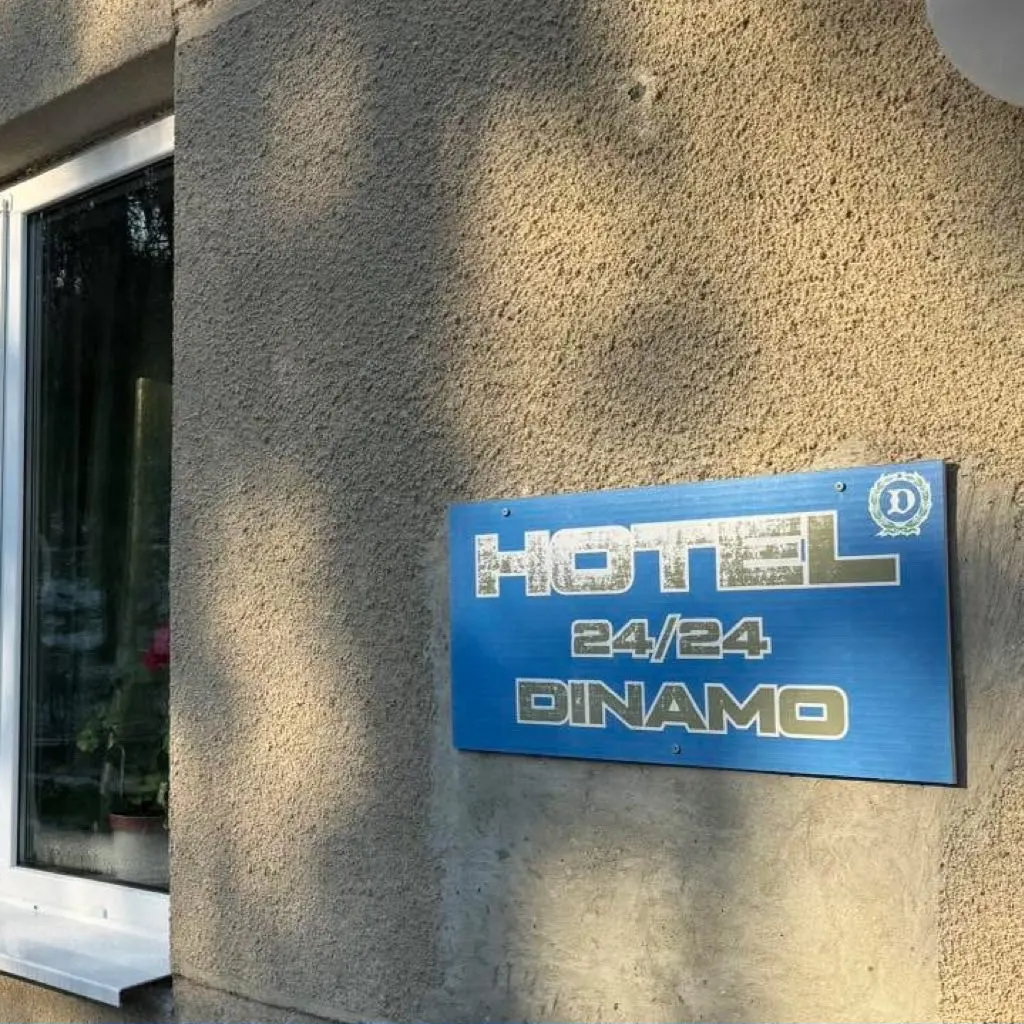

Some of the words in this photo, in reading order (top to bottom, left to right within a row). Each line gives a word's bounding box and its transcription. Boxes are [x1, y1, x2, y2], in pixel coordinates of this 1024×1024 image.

[887, 489, 916, 515] D
[475, 510, 900, 598] HOTEL
[571, 613, 771, 663] 24/24
[515, 678, 849, 740] DINAMO
